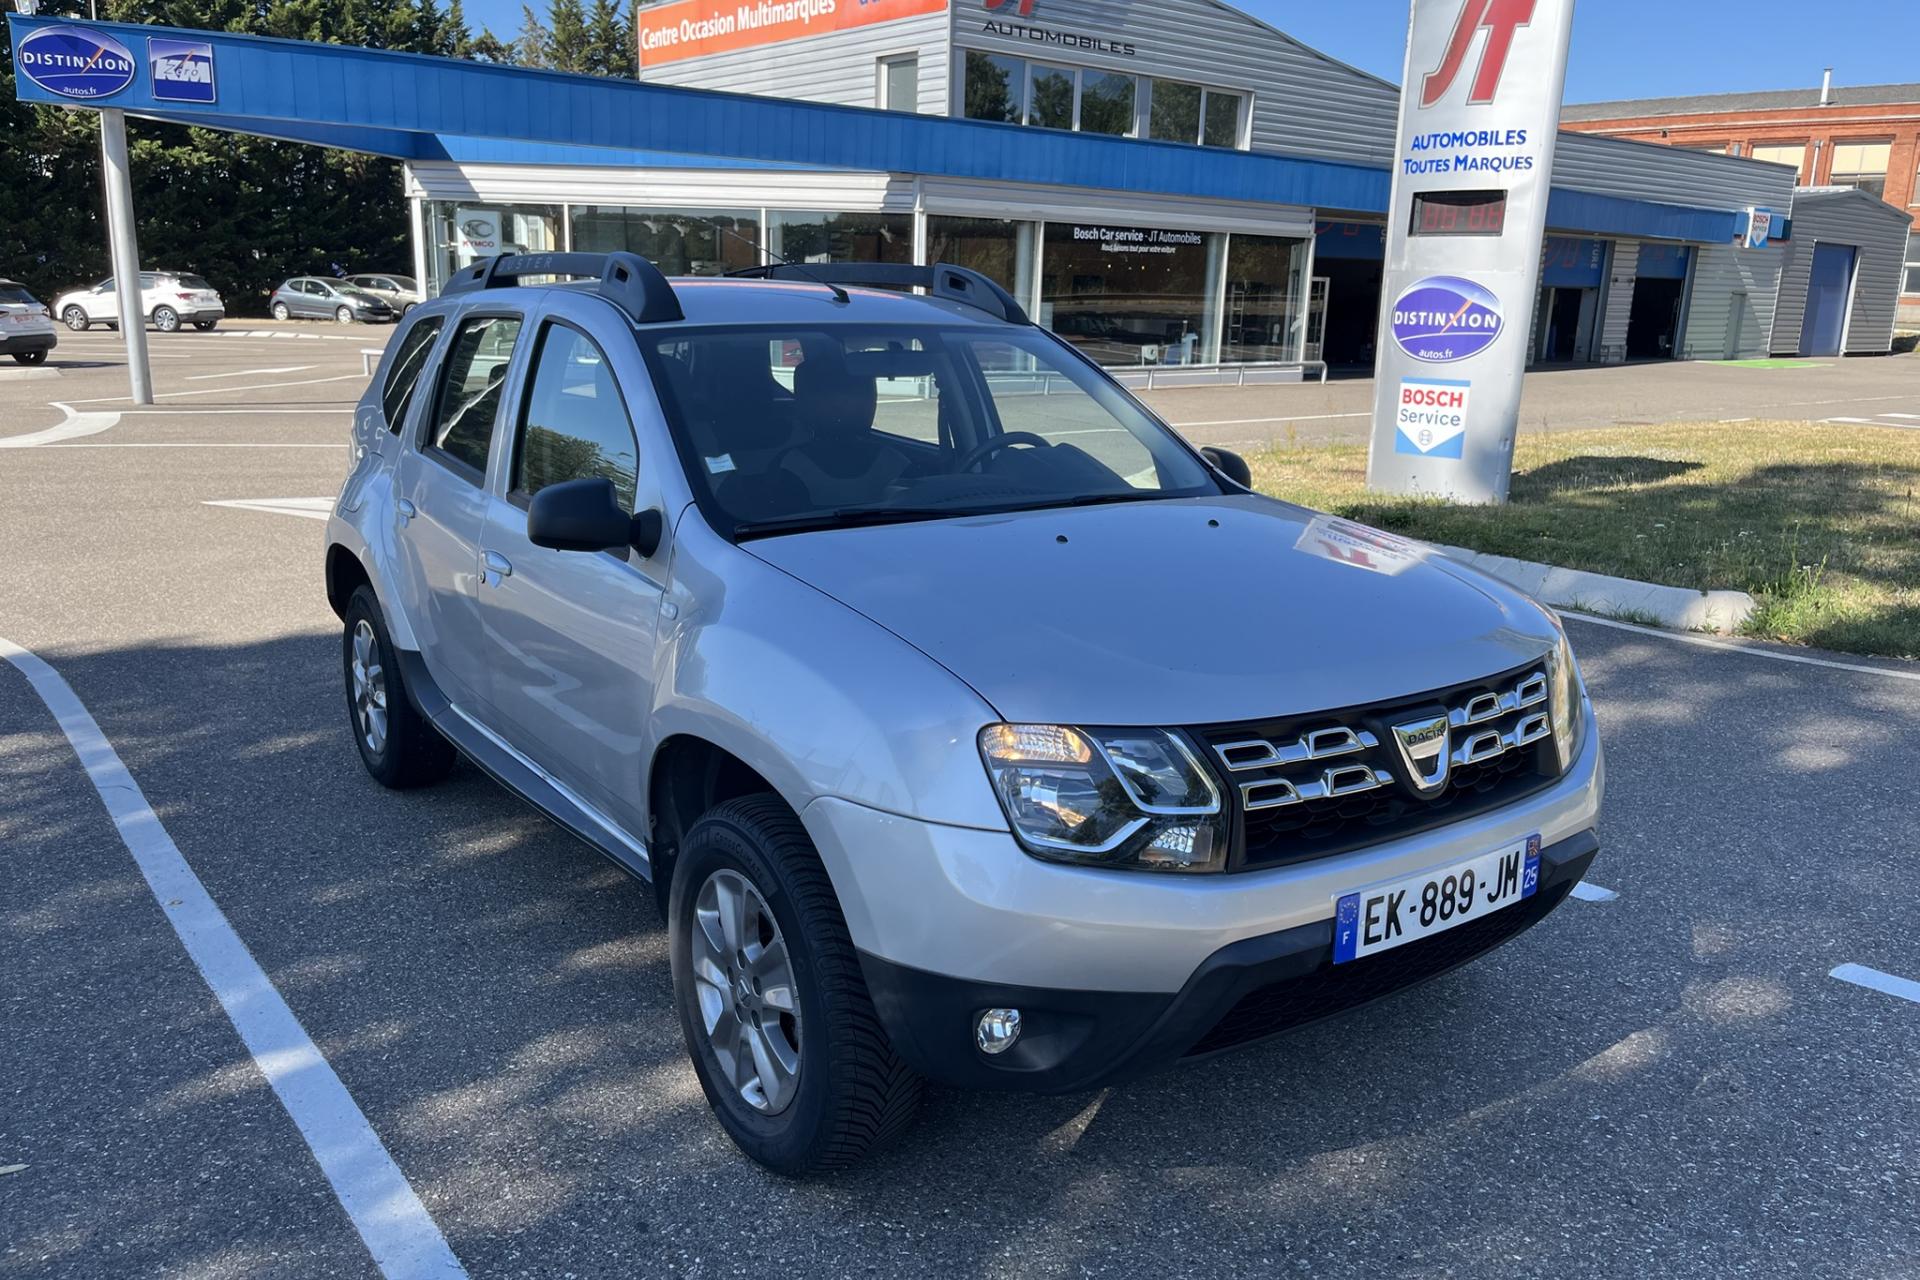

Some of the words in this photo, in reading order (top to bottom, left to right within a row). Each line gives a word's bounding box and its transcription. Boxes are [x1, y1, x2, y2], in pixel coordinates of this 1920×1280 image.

[641, 27, 678, 50] Centre
[680, 14, 735, 42] Occasion
[737, 0, 836, 30] Multimarques
[983, 21, 1135, 56] AUTOMOBILES
[23, 50, 129, 73] DISTINXION
[63, 86, 97, 96] autos.fr
[1411, 130, 1527, 151] AUTOMOBILES
[1073, 227, 1099, 240] Bosch
[1100, 228, 1114, 241] Car
[1114, 229, 1144, 241] service
[1148, 231, 1158, 242] JT
[1158, 231, 1202, 244] Automobiles
[1394, 308, 1497, 330] DISTINXION
[1418, 349, 1453, 360] autos.fr
[1402, 388, 1463, 409] BOSCH
[1399, 408, 1461, 427] Service
[1409, 729, 1445, 744] DACIA
[1523, 865, 1537, 889] 25
[1342, 931, 1350, 945] F
